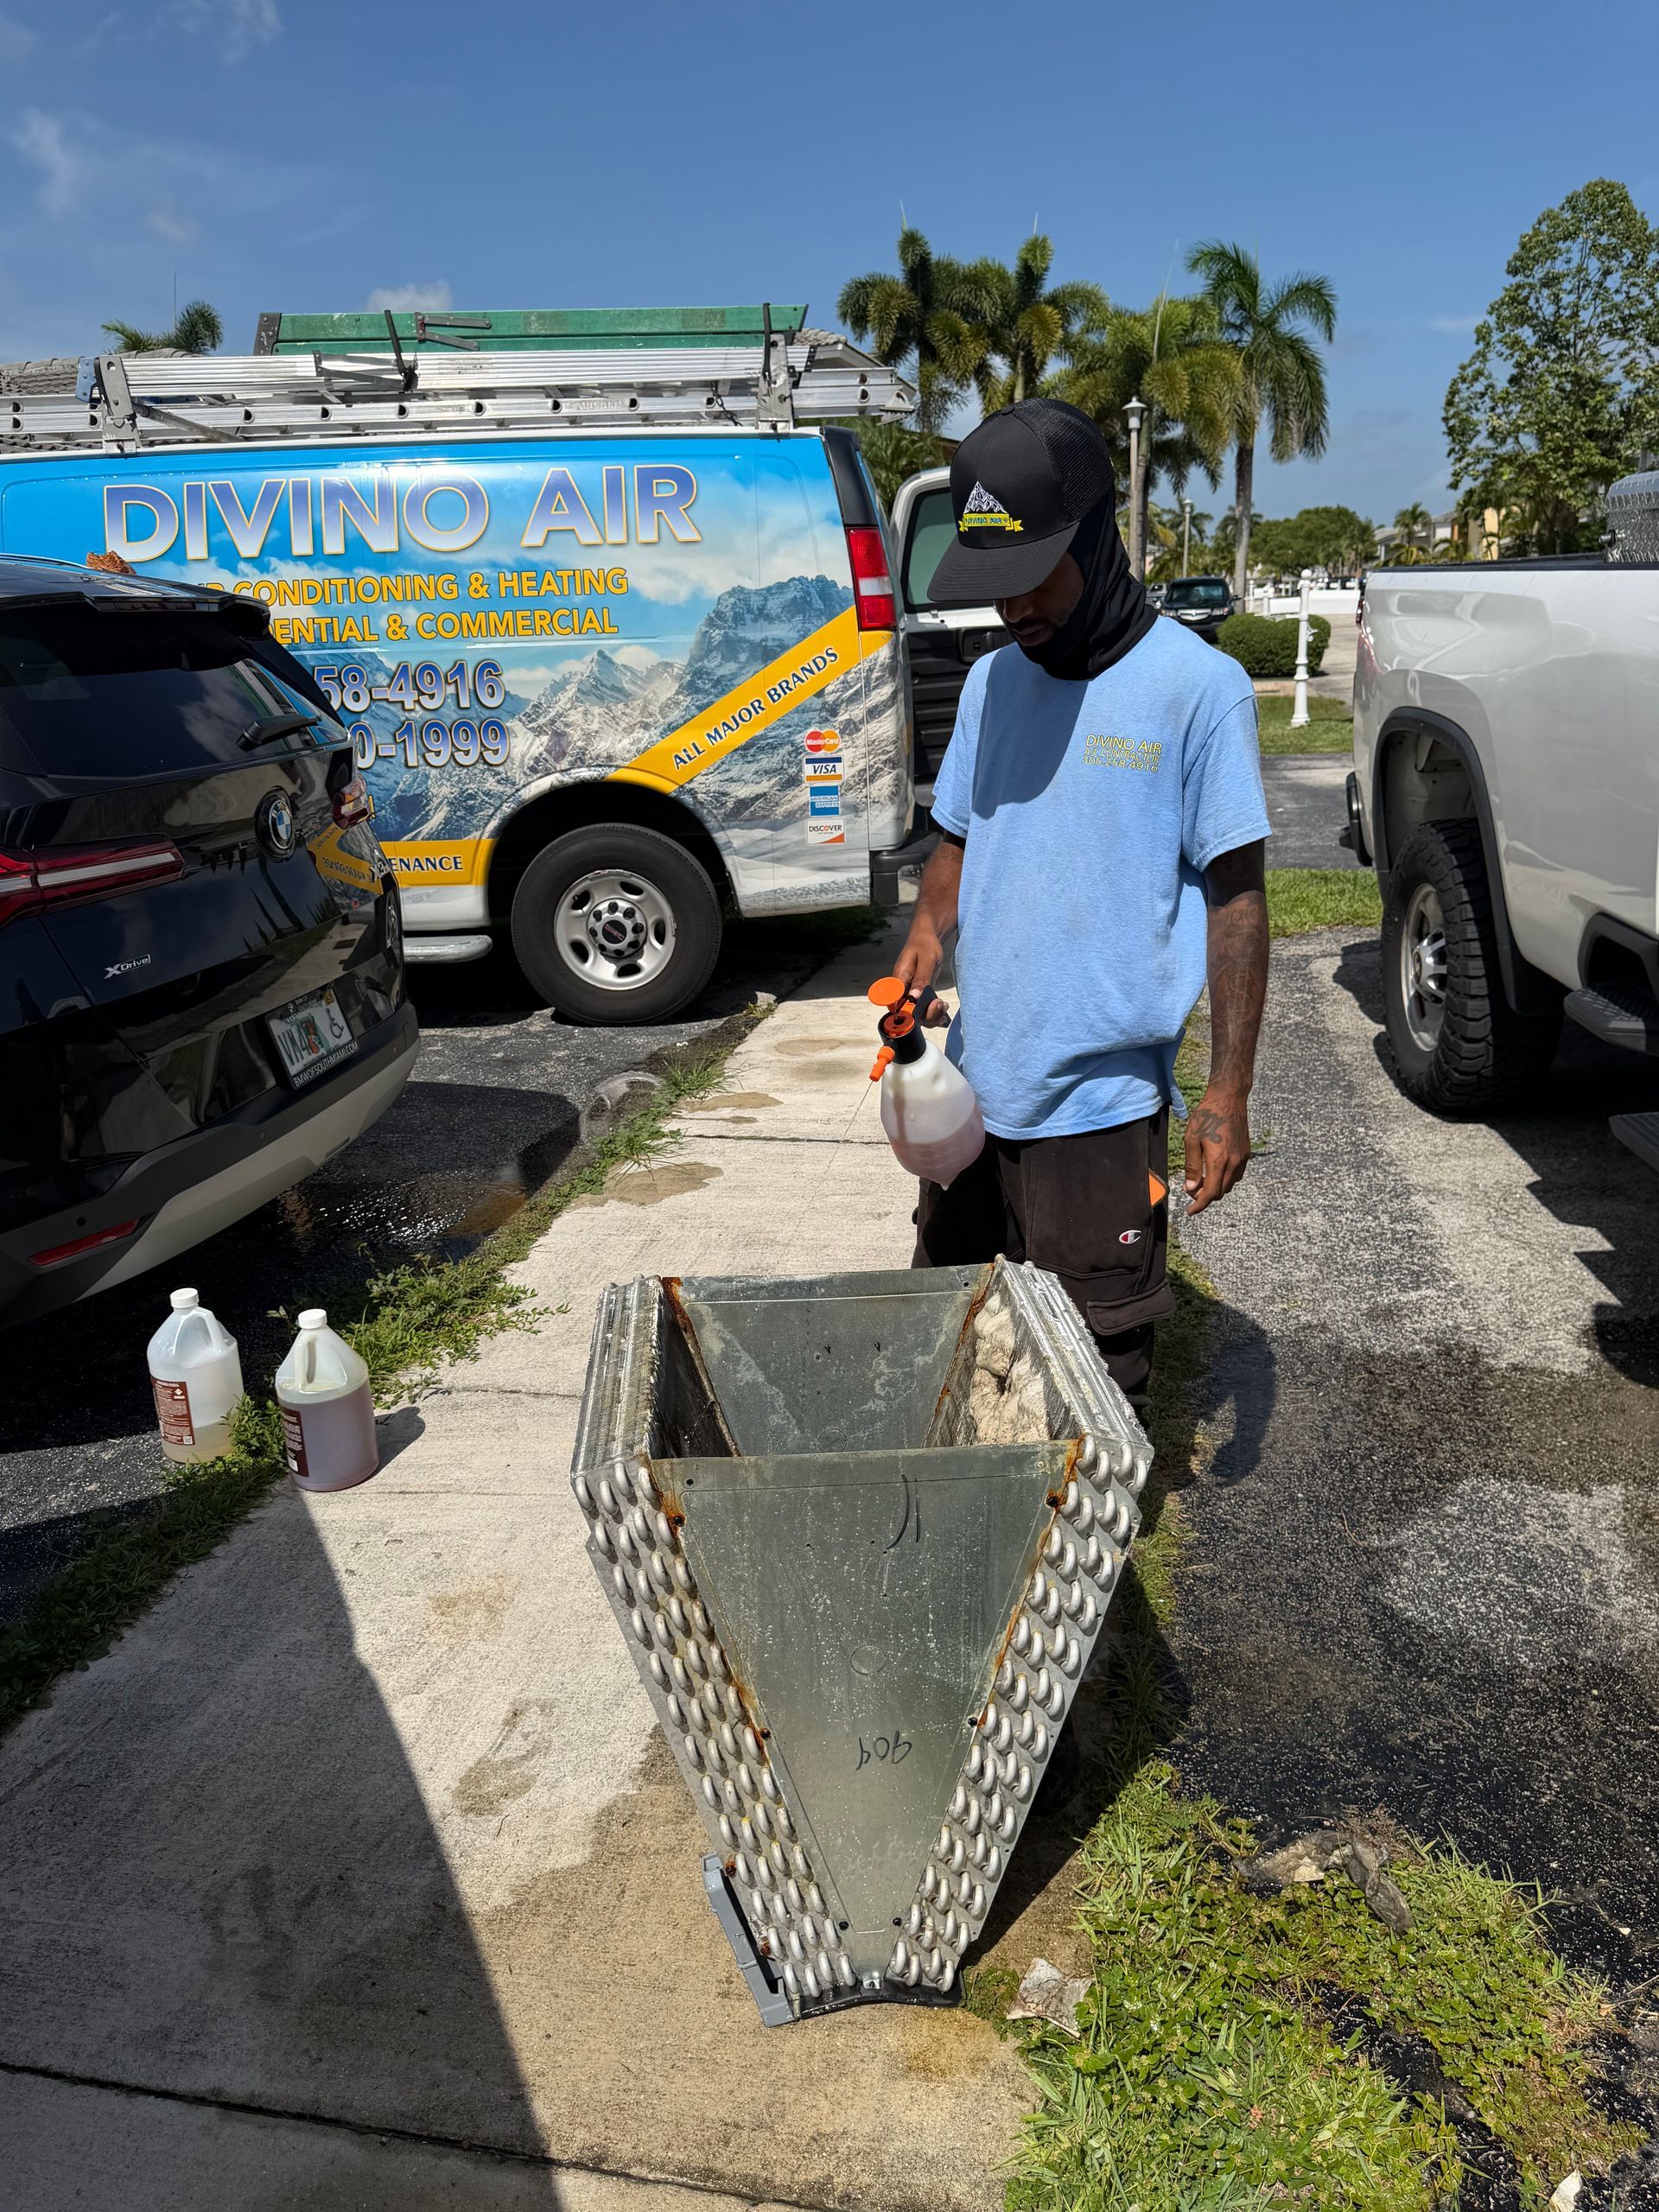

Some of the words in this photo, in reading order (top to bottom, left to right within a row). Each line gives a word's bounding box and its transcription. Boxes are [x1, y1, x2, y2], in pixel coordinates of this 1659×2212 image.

[103, 472, 490, 563] DIVINO
[520, 464, 702, 547] AIR
[467, 571, 490, 599] &
[499, 567, 629, 598] HEATING
[386, 613, 409, 641] &
[416, 607, 619, 639] COMMERCIAL
[672, 741, 706, 769] ALL
[705, 698, 766, 746] MAJOR
[766, 647, 838, 704] BRANDS
[1086, 734, 1135, 750] DIVINO
[1137, 741, 1162, 754] AIR
[812, 764, 837, 774] VISA
[1083, 756, 1159, 772] 305.258.4916
